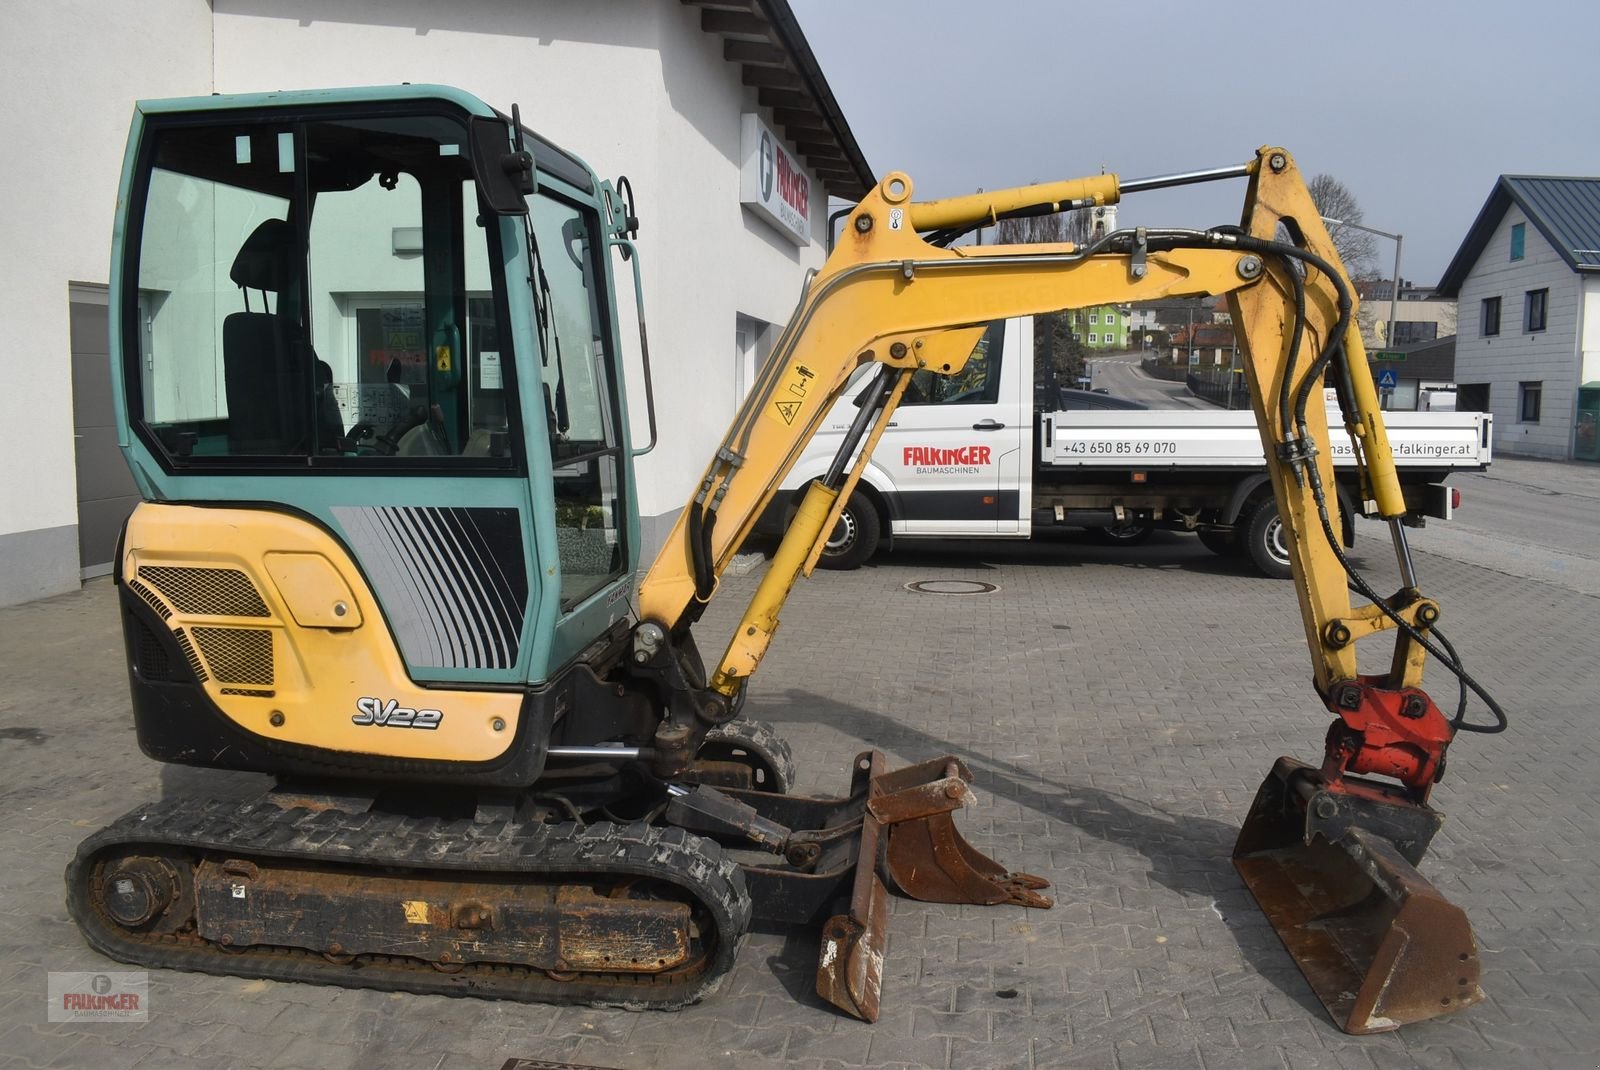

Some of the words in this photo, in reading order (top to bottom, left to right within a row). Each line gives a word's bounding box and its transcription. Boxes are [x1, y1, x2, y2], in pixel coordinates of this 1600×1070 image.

[776, 145, 809, 221] FALKINGER
[903, 446, 991, 466] FALKINGER
[1063, 442, 1086, 454] +43
[1090, 442, 1112, 454] 650
[1116, 442, 1131, 454] 85
[1135, 442, 1150, 454] 69
[1153, 442, 1176, 454] 070
[352, 697, 443, 730] SV22
